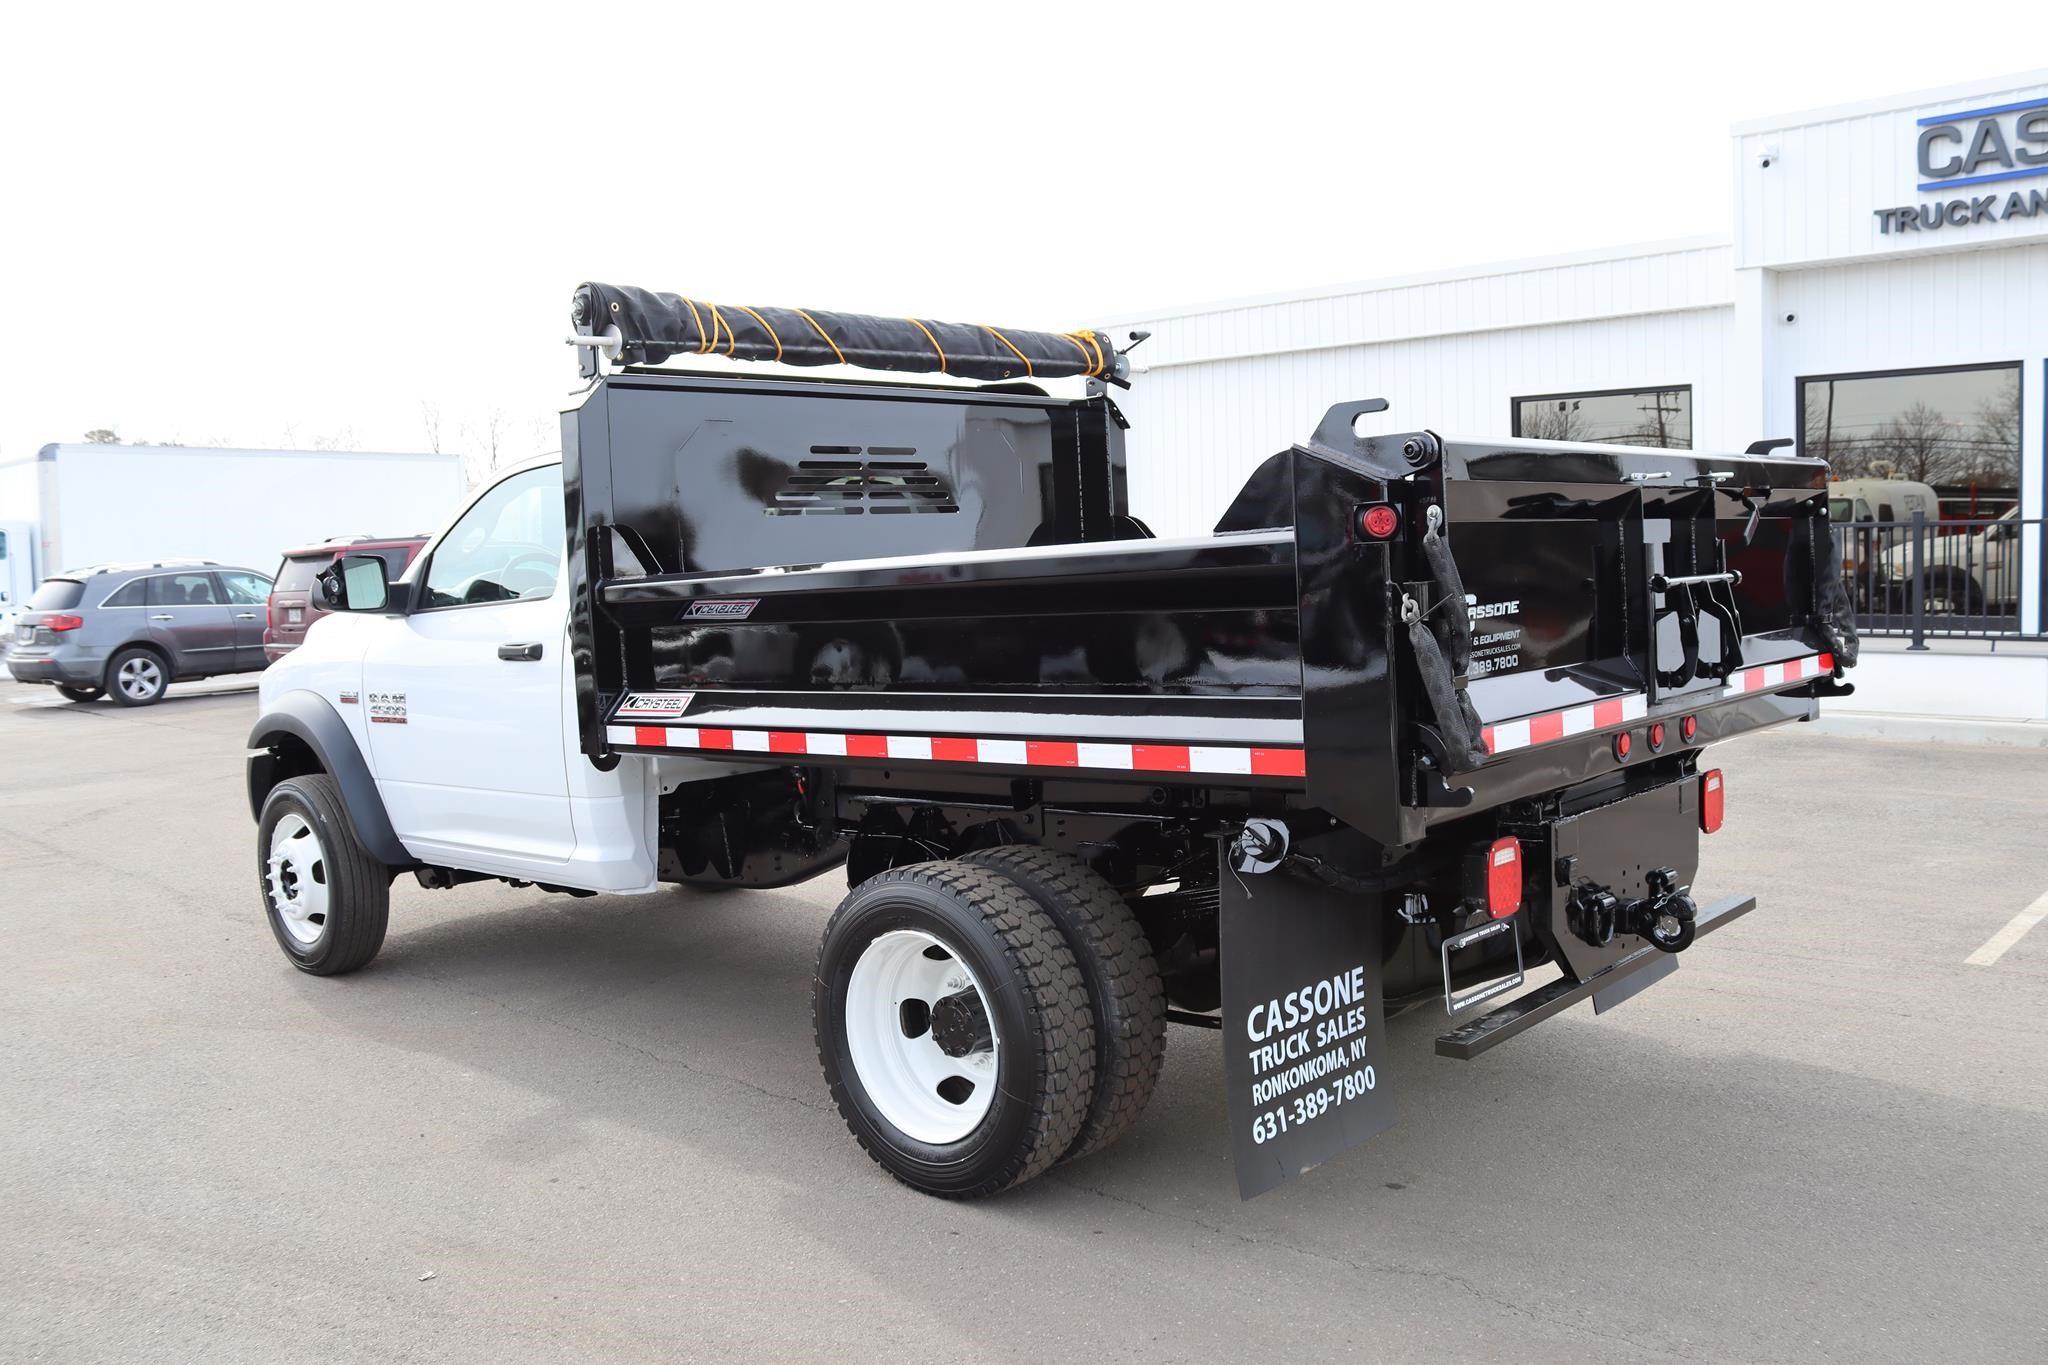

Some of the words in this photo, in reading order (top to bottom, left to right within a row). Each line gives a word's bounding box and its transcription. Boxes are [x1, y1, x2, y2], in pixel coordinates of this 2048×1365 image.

[1873, 194, 1997, 234] TRUCK
[1473, 636, 1479, 646] &
[1480, 629, 1521, 645] EQUIPMENT
[634, 698, 682, 709] CRYSTEEL
[1247, 966, 1365, 1042] CASSONE
[1249, 1029, 1311, 1076] TRUCK
[1316, 1006, 1366, 1048] SALES
[1252, 1046, 1350, 1107] RONKONKOMA,
[1350, 1036, 1367, 1062] NY
[1252, 1065, 1376, 1145] 631-389-7800
